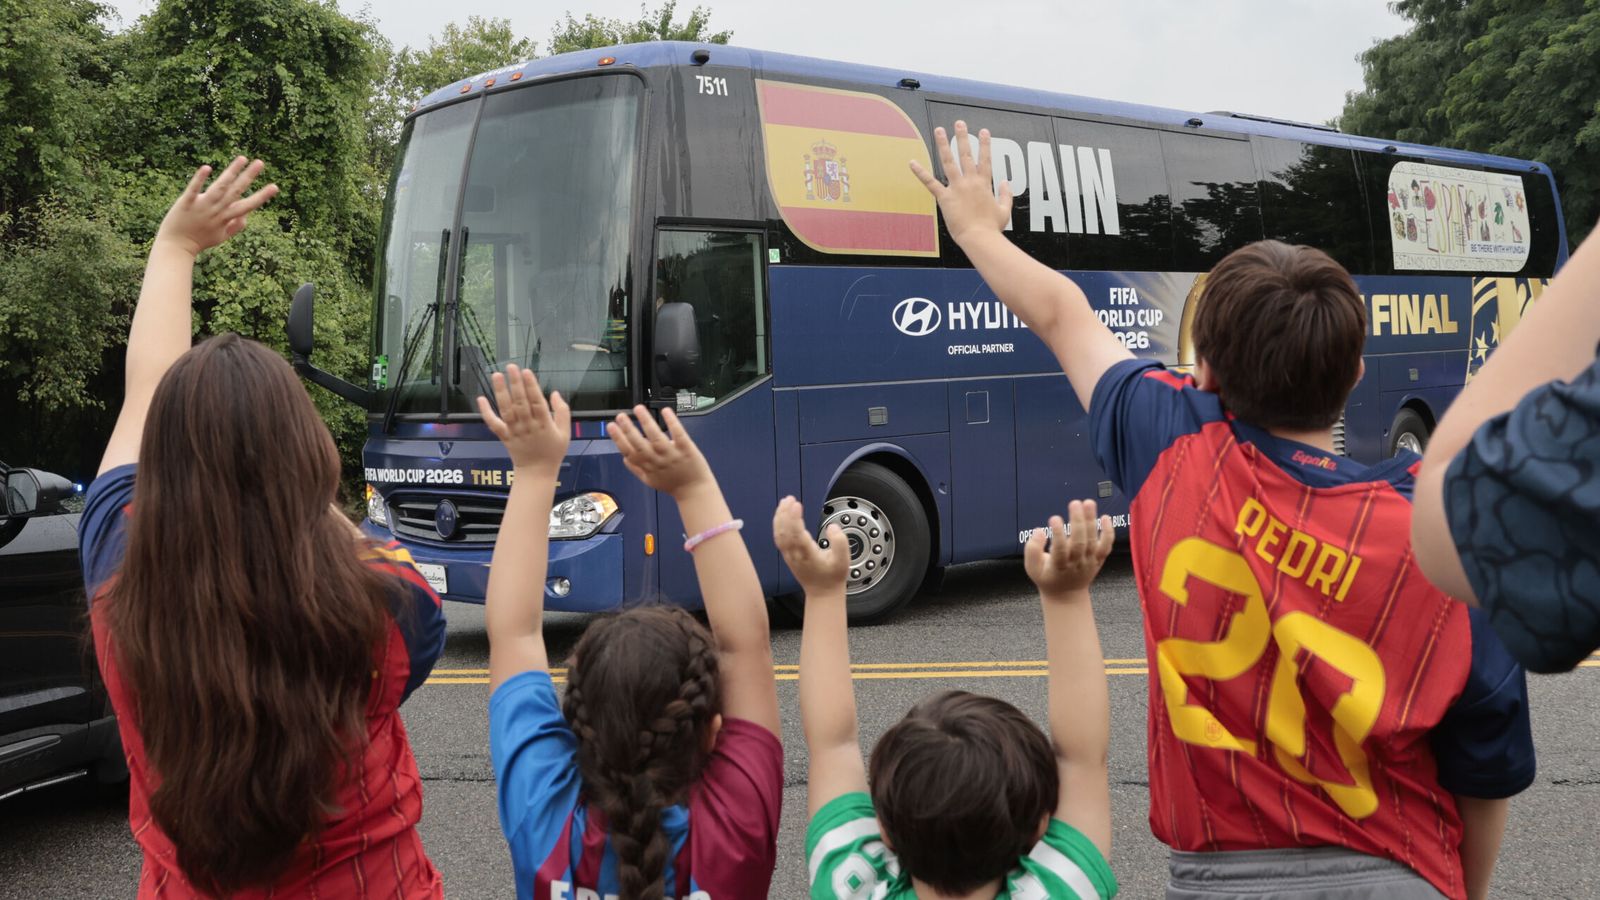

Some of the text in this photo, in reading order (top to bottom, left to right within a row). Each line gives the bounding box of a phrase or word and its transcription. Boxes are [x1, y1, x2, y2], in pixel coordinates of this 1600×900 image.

[696, 75, 728, 96] 7511
[1110, 287, 1139, 305] FIFA
[1094, 308, 1163, 327] ORLD CUP
[1372, 294, 1458, 336] FINAL
[948, 343, 1014, 355] OFFICIAL PARTNER
[1291, 449, 1337, 471] España
[364, 467, 377, 481] FIFA
[377, 468, 405, 483] WORLD
[406, 468, 425, 483] CUP
[425, 469, 464, 484] 2026
[471, 469, 502, 485] THE
[1234, 496, 1361, 602] PEDRI
[1157, 536, 1386, 819] 20
